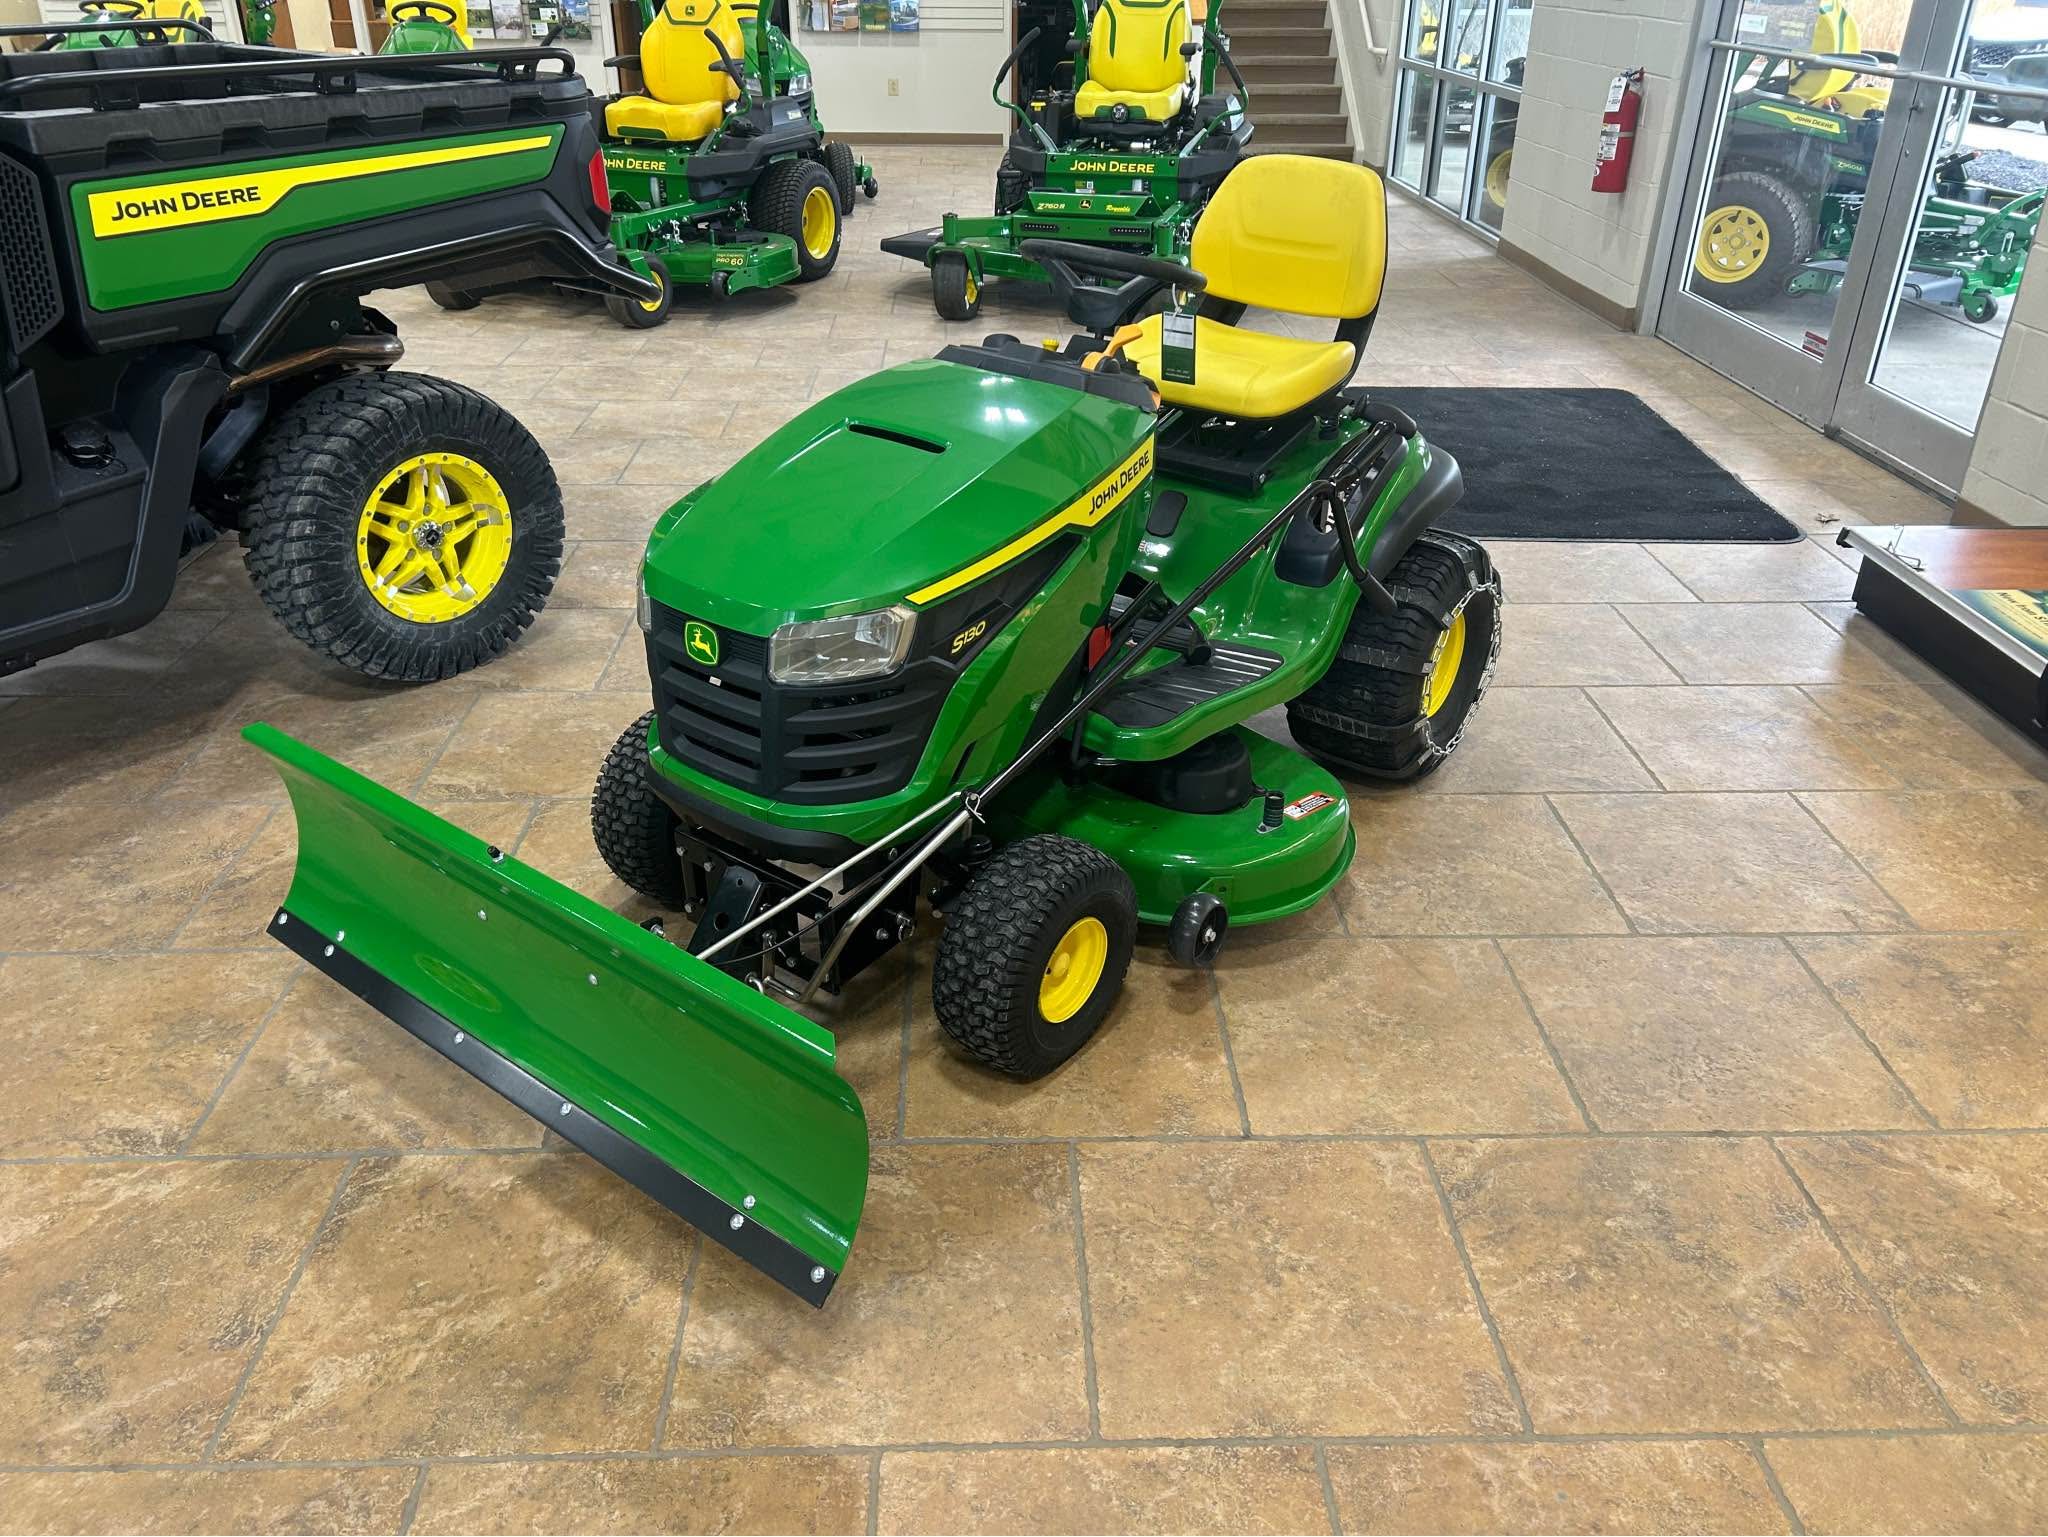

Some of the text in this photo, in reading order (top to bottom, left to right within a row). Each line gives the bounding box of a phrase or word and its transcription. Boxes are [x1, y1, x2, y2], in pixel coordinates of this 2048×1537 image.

[603, 158, 666, 171] OHN DEERE
[1070, 160, 1155, 173] JOHN DEERE
[111, 186, 261, 221] JOHN DEERE
[730, 258, 744, 266] 60
[1089, 450, 1150, 516] JOHN DEERE
[951, 620, 986, 654] S130
